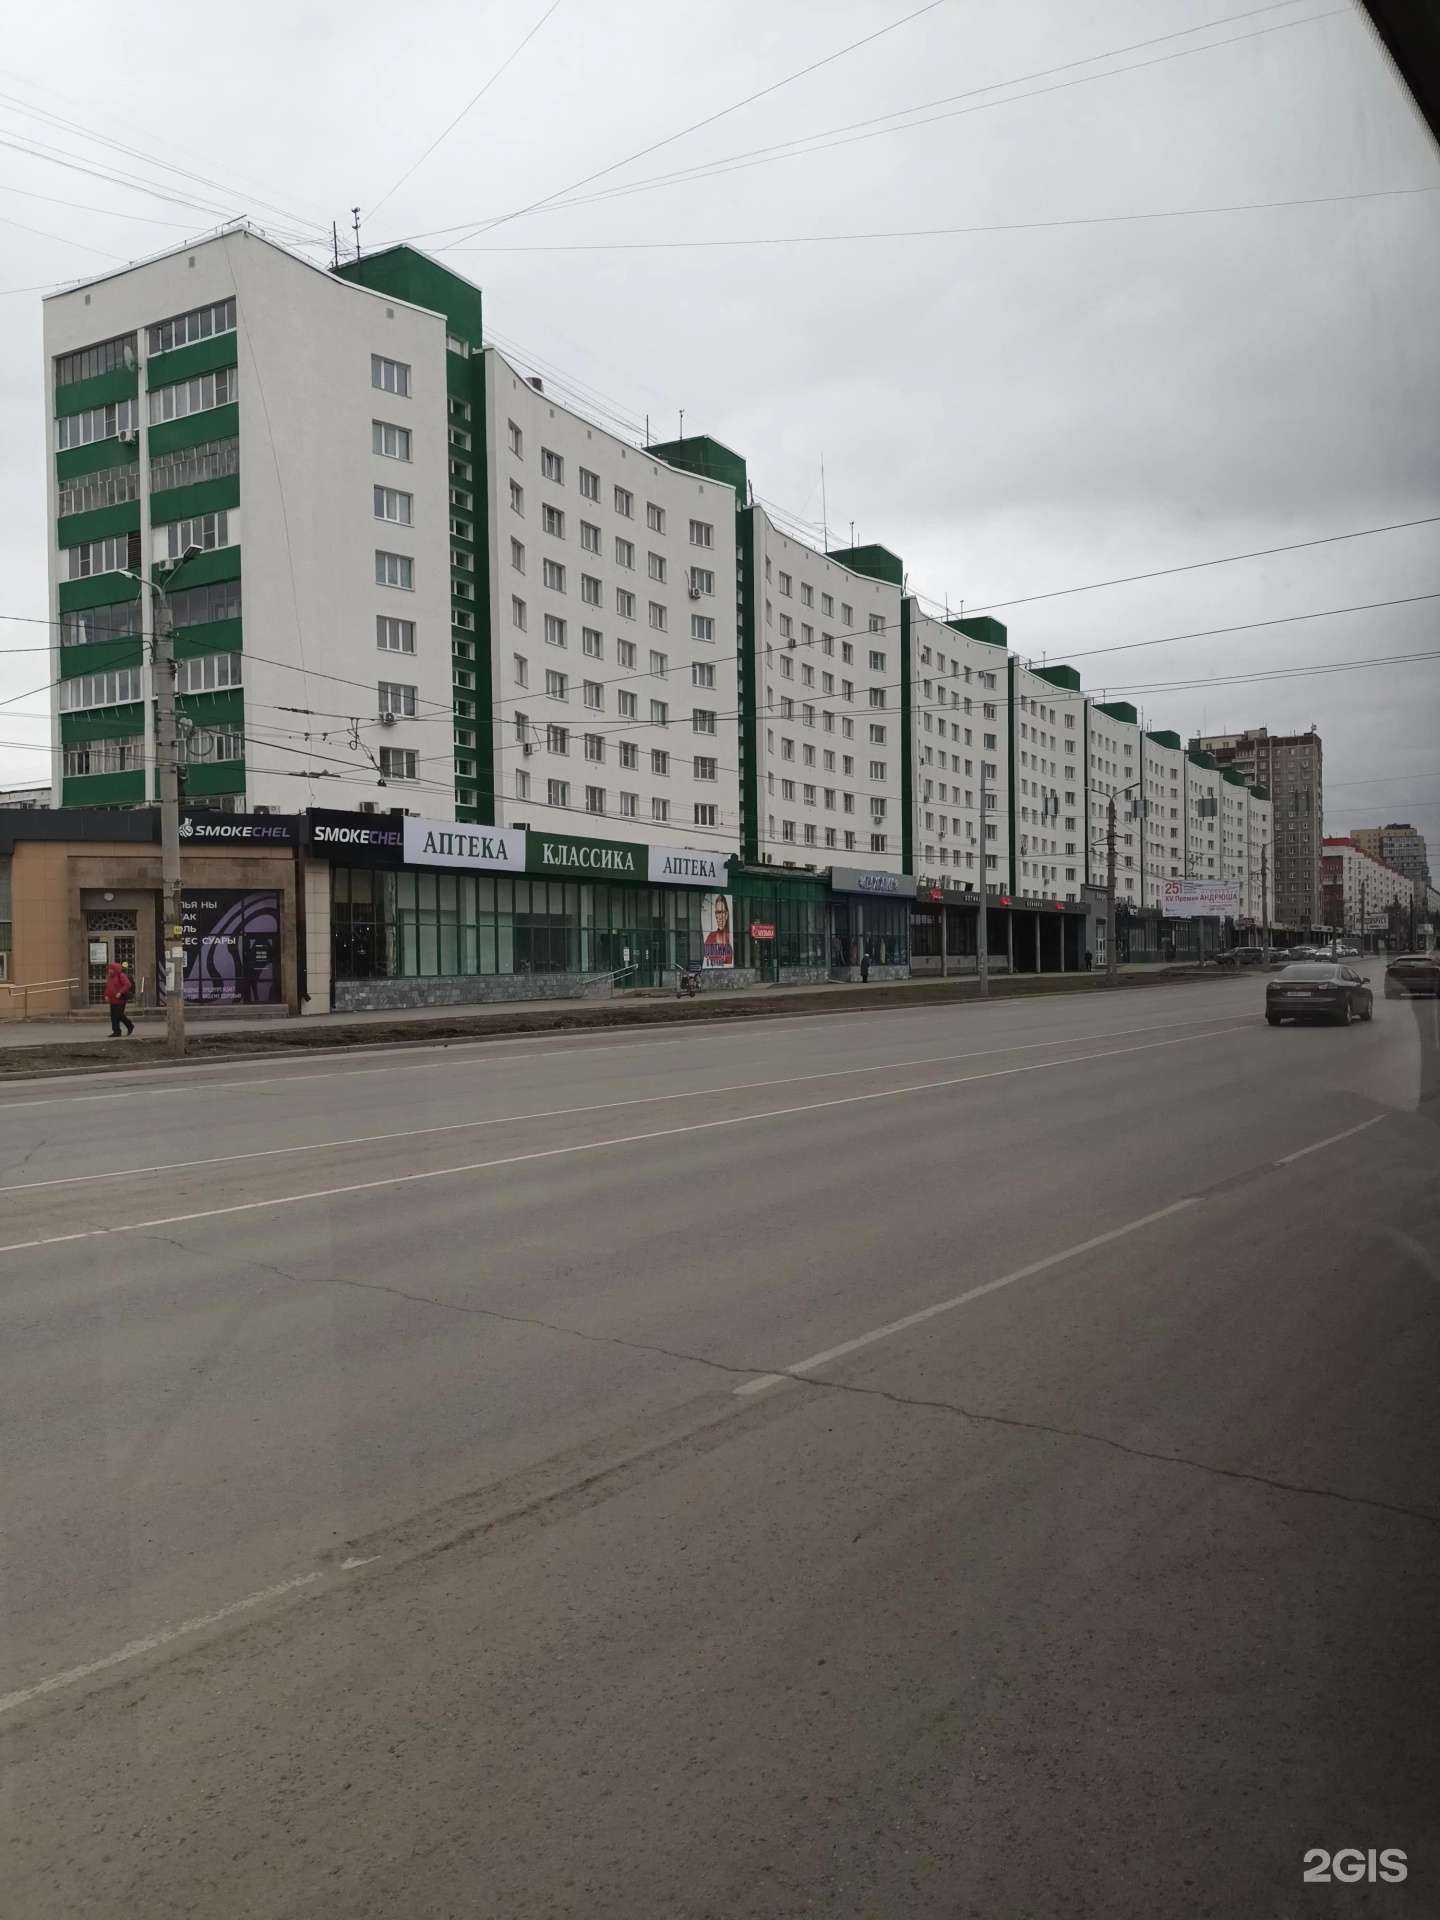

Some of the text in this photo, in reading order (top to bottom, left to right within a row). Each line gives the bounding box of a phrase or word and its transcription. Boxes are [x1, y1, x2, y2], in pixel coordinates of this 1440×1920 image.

[194, 825, 291, 838] SMOKECHEL
[313, 825, 404, 846] SMOKECHEL
[423, 831, 509, 861] АПТЕКА
[542, 843, 635, 871] КЛАССИКА
[662, 857, 717, 878] АПТЕКА
[201, 901, 217, 909] НЫ
